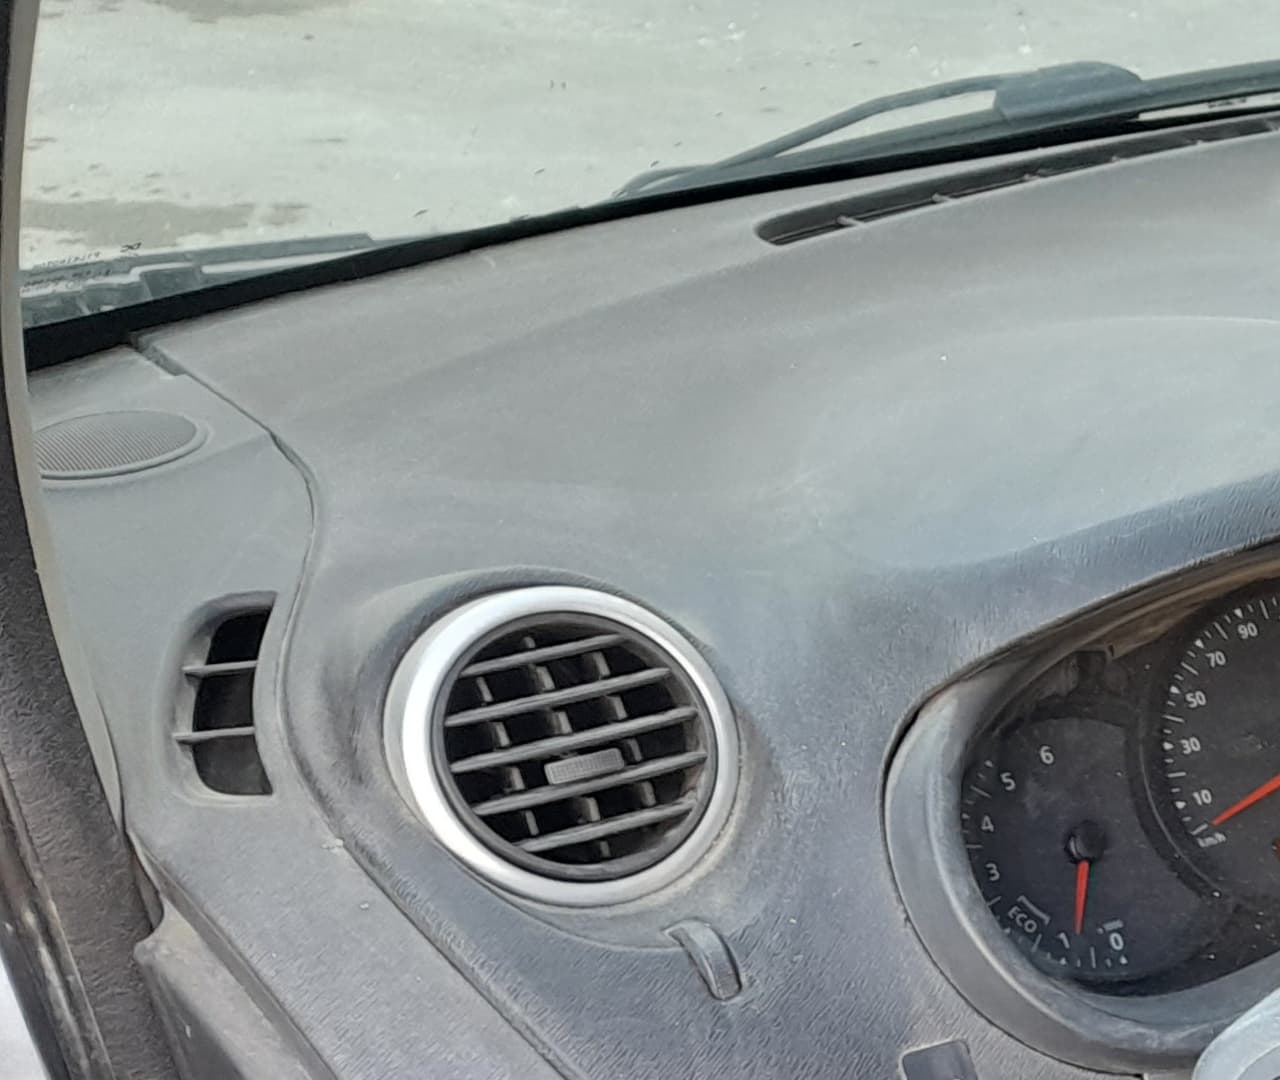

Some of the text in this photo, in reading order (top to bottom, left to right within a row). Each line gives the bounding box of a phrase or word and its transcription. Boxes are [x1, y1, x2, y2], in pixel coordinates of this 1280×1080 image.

[1237, 622, 1258, 639] 90
[1206, 651, 1226, 668] 70
[1185, 691, 1207, 708] 50
[1179, 737, 1201, 754] 30
[1039, 746, 1054, 764] 6
[1000, 772, 1016, 791] 5
[1192, 789, 1212, 805] 10
[981, 815, 994, 832] 4
[985, 863, 1000, 881] 3
[1007, 906, 1038, 933] ECO
[1057, 932, 1070, 949] 1
[1109, 933, 1124, 950] 0
